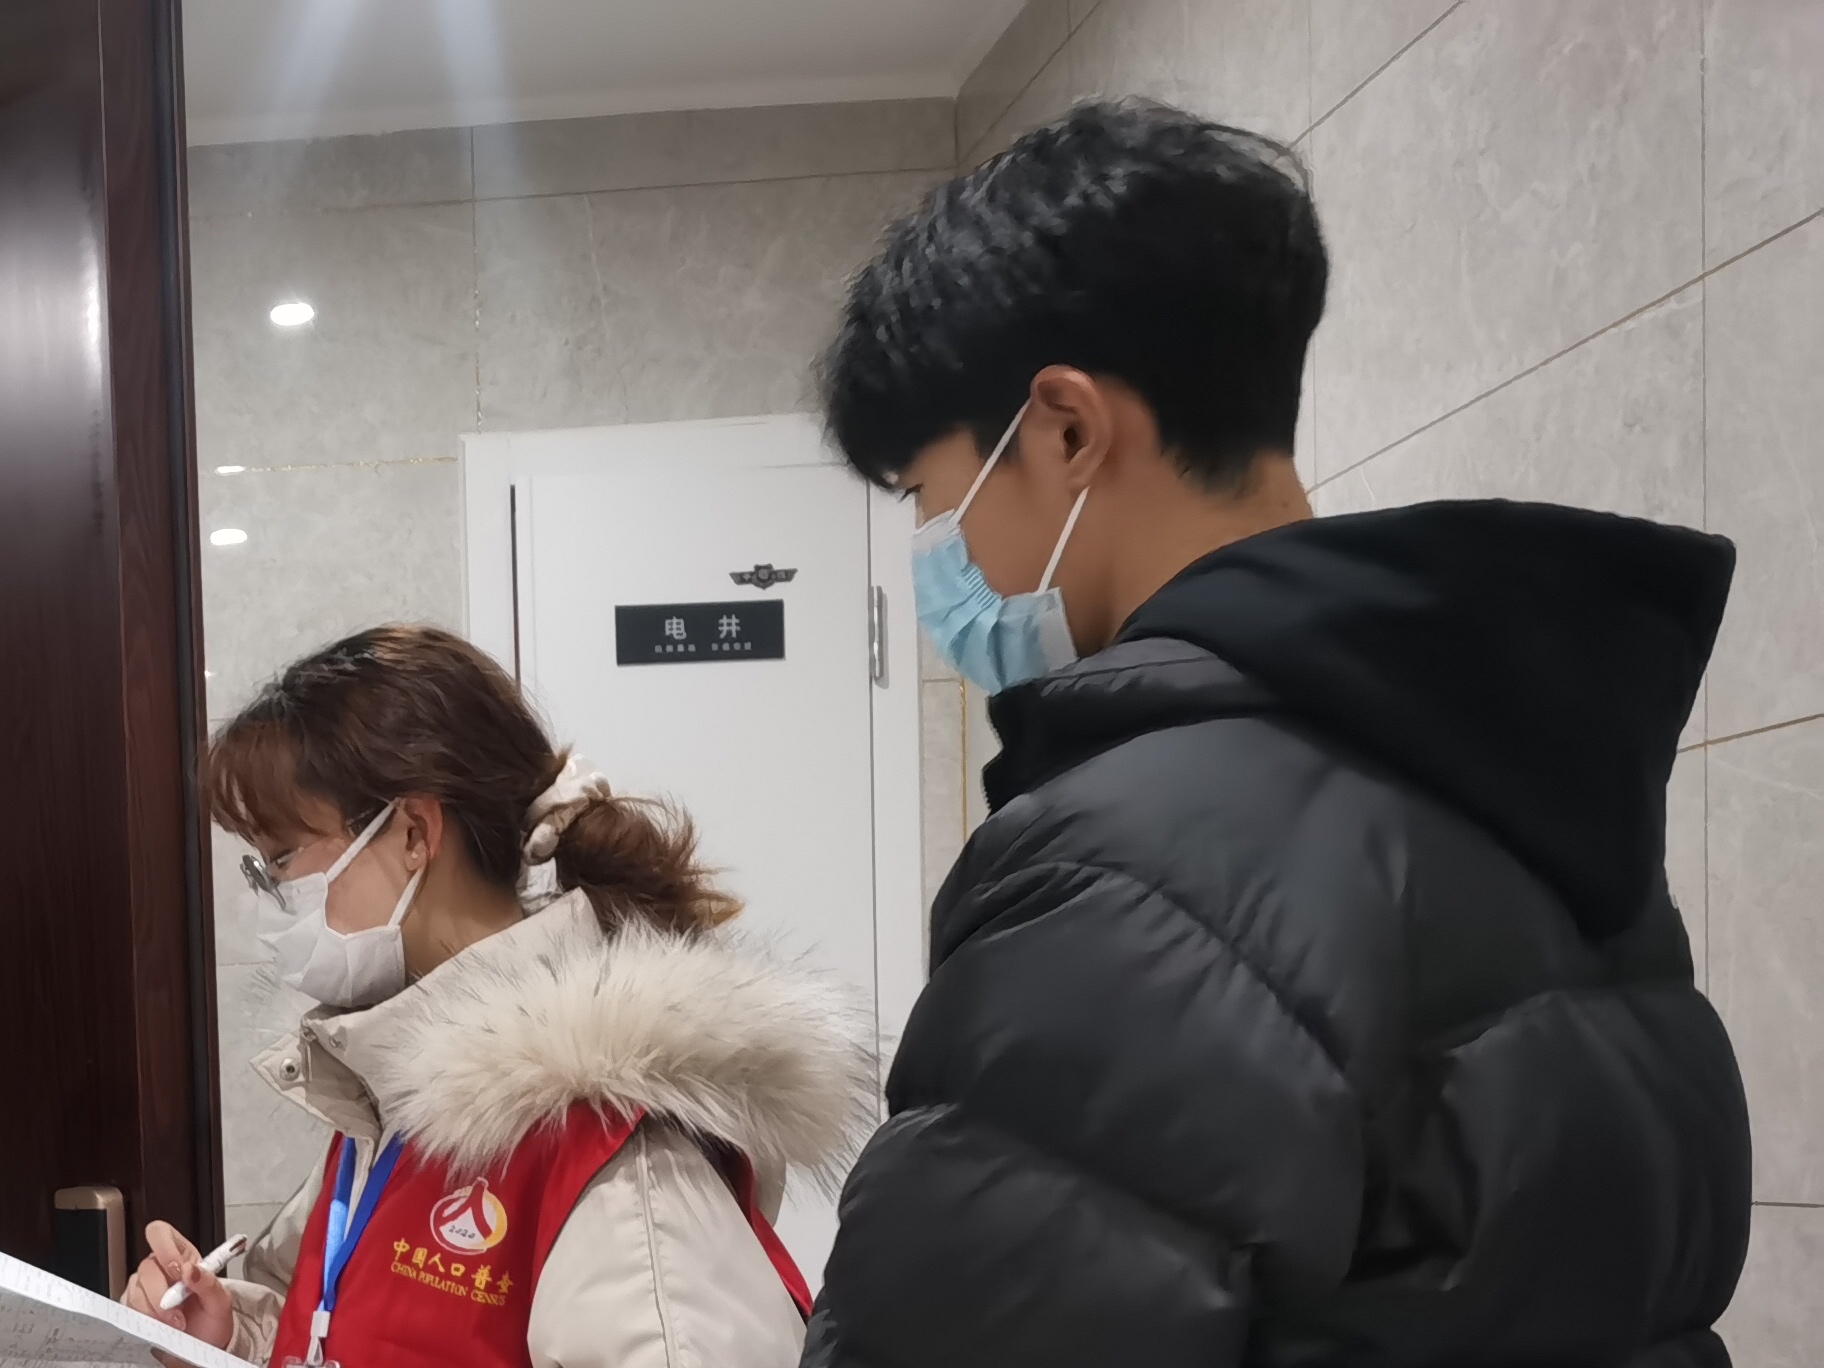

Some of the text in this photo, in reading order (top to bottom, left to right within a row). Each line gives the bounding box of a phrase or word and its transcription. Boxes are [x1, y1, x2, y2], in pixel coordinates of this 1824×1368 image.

[391, 1260, 417, 1280] CHINA
[393, 1237, 514, 1294] 中国人口普查
